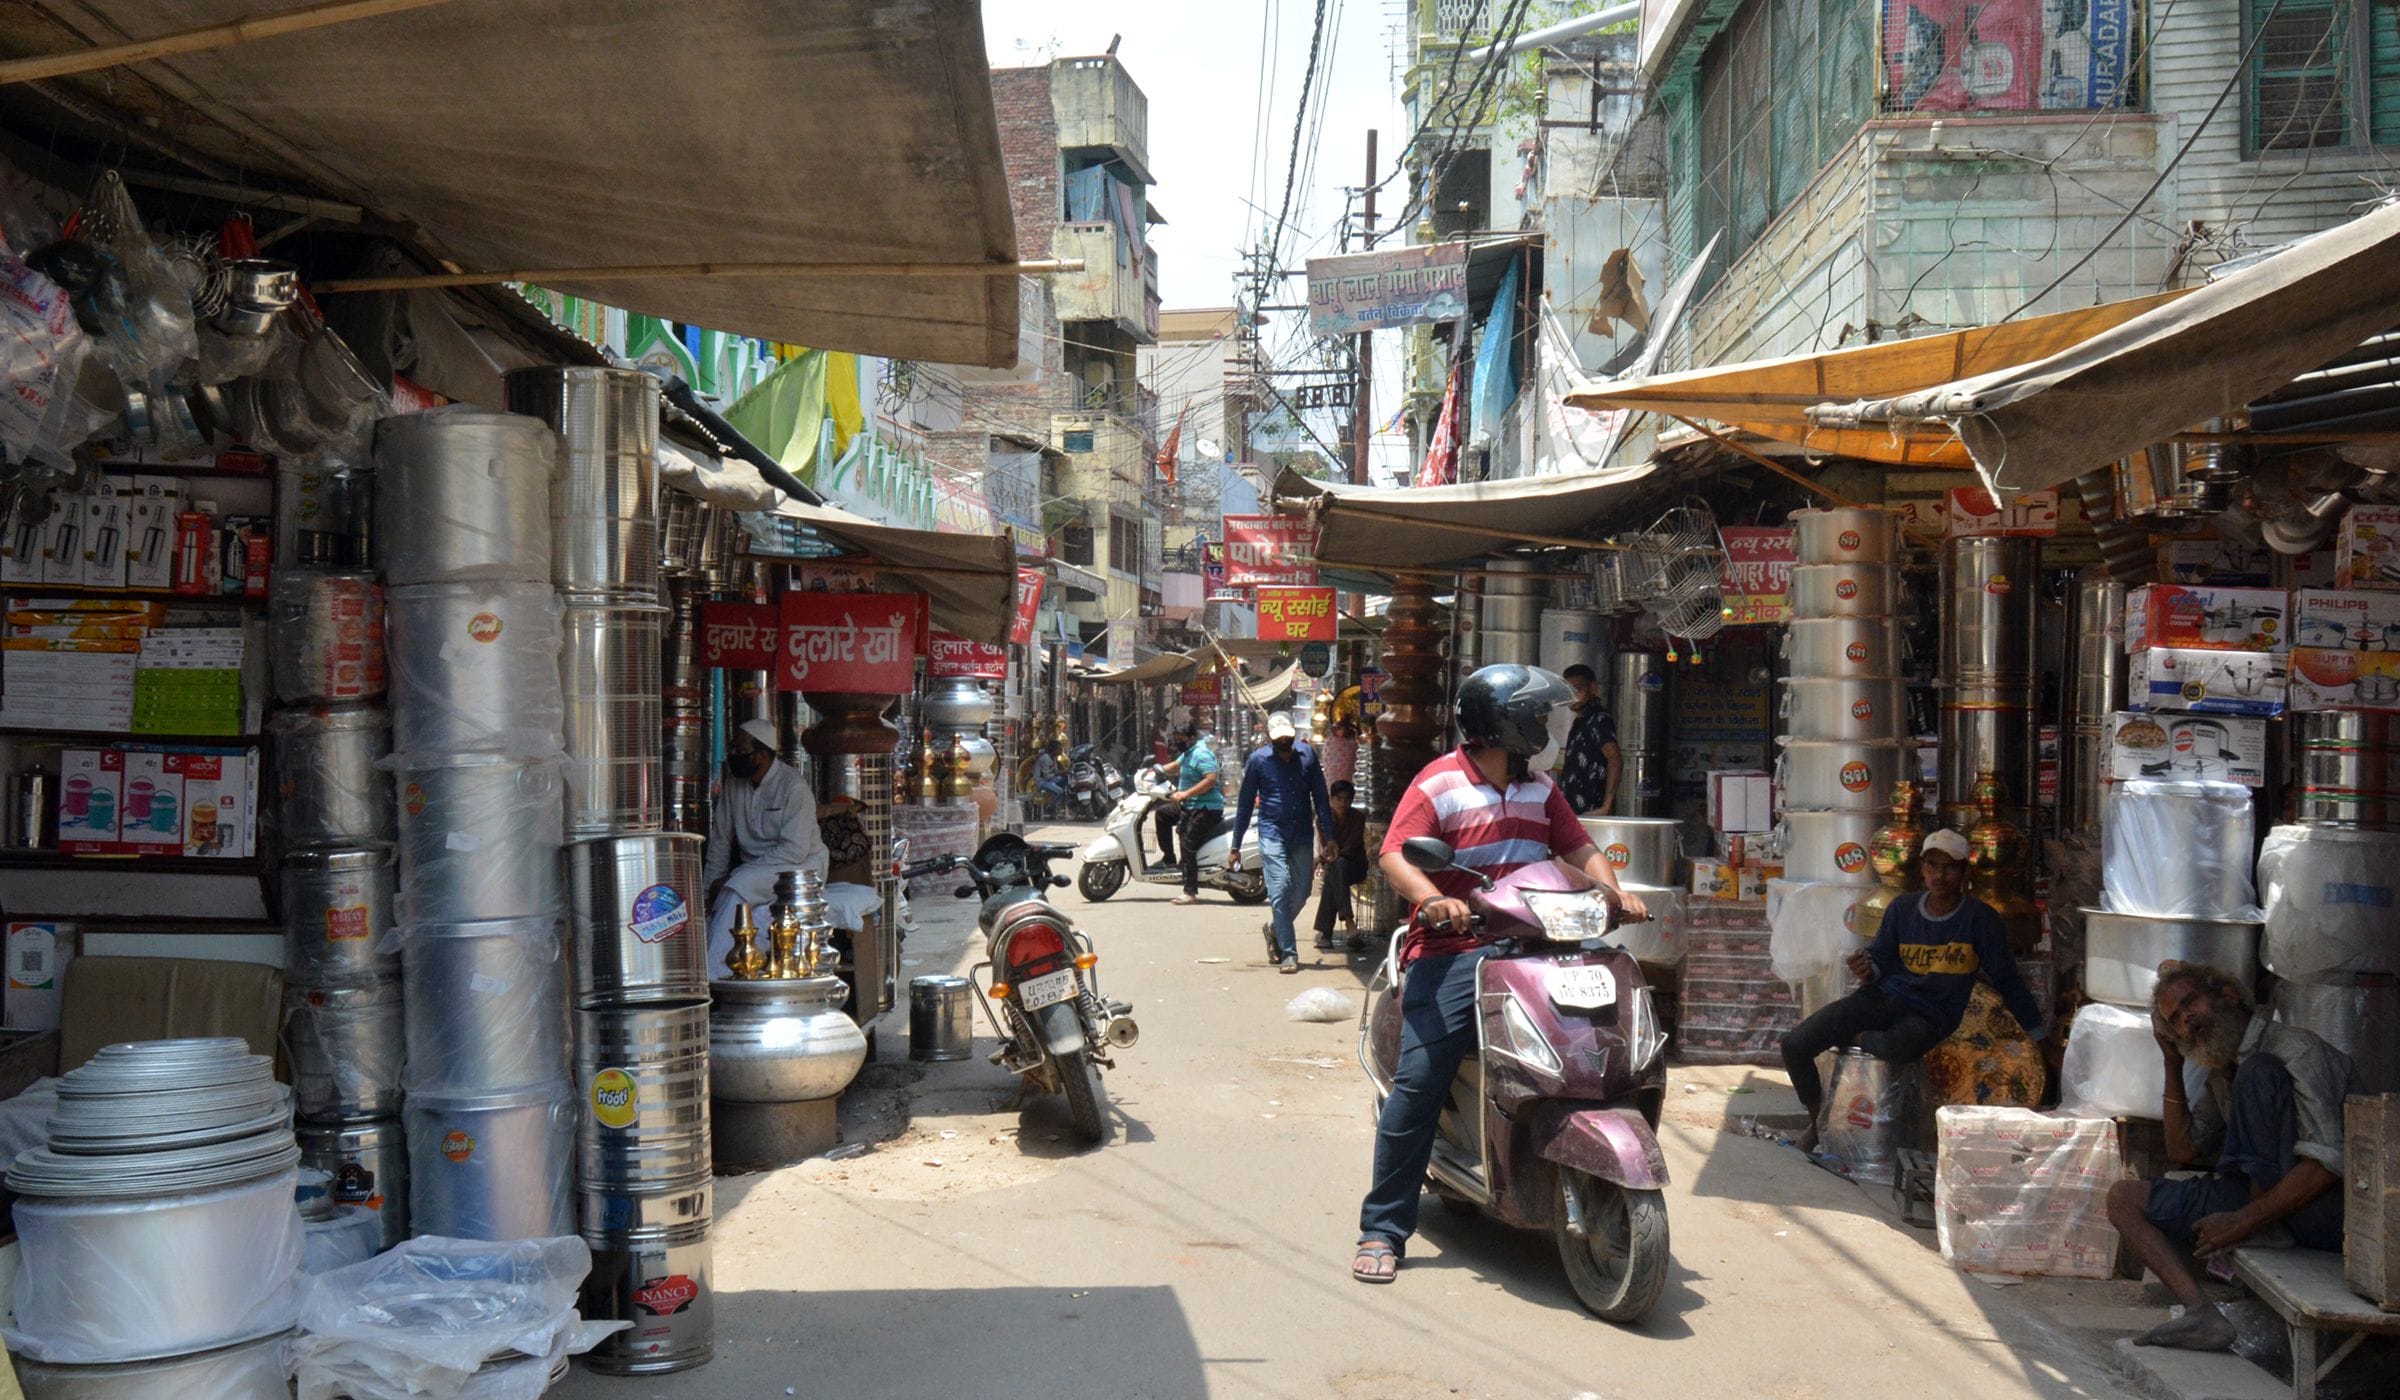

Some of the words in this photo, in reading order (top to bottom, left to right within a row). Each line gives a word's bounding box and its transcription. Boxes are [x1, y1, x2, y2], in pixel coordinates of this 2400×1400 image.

[2095, 0, 2120, 110] MURADA
[1344, 273, 1381, 303] लाल
[1385, 263, 1418, 296] गंगा
[1357, 305, 1385, 321] बर्तन
[1230, 532, 1274, 567] प्यारे
[1730, 536, 1760, 554] न्यू
[1260, 598, 1285, 622] न्यू
[1286, 592, 1332, 619] रसोई
[2308, 598, 2369, 611] PHILIPS
[706, 618, 758, 659] दुलारे
[1285, 621, 1312, 639] घर
[788, 613, 858, 680] दुलारे
[862, 611, 906, 664] खाँ
[984, 659, 1004, 673] स्टोर
[2313, 655, 2356, 665] SURYA
[597, 1087, 629, 1106] Frooti
[641, 1283, 692, 1303] NANCY
